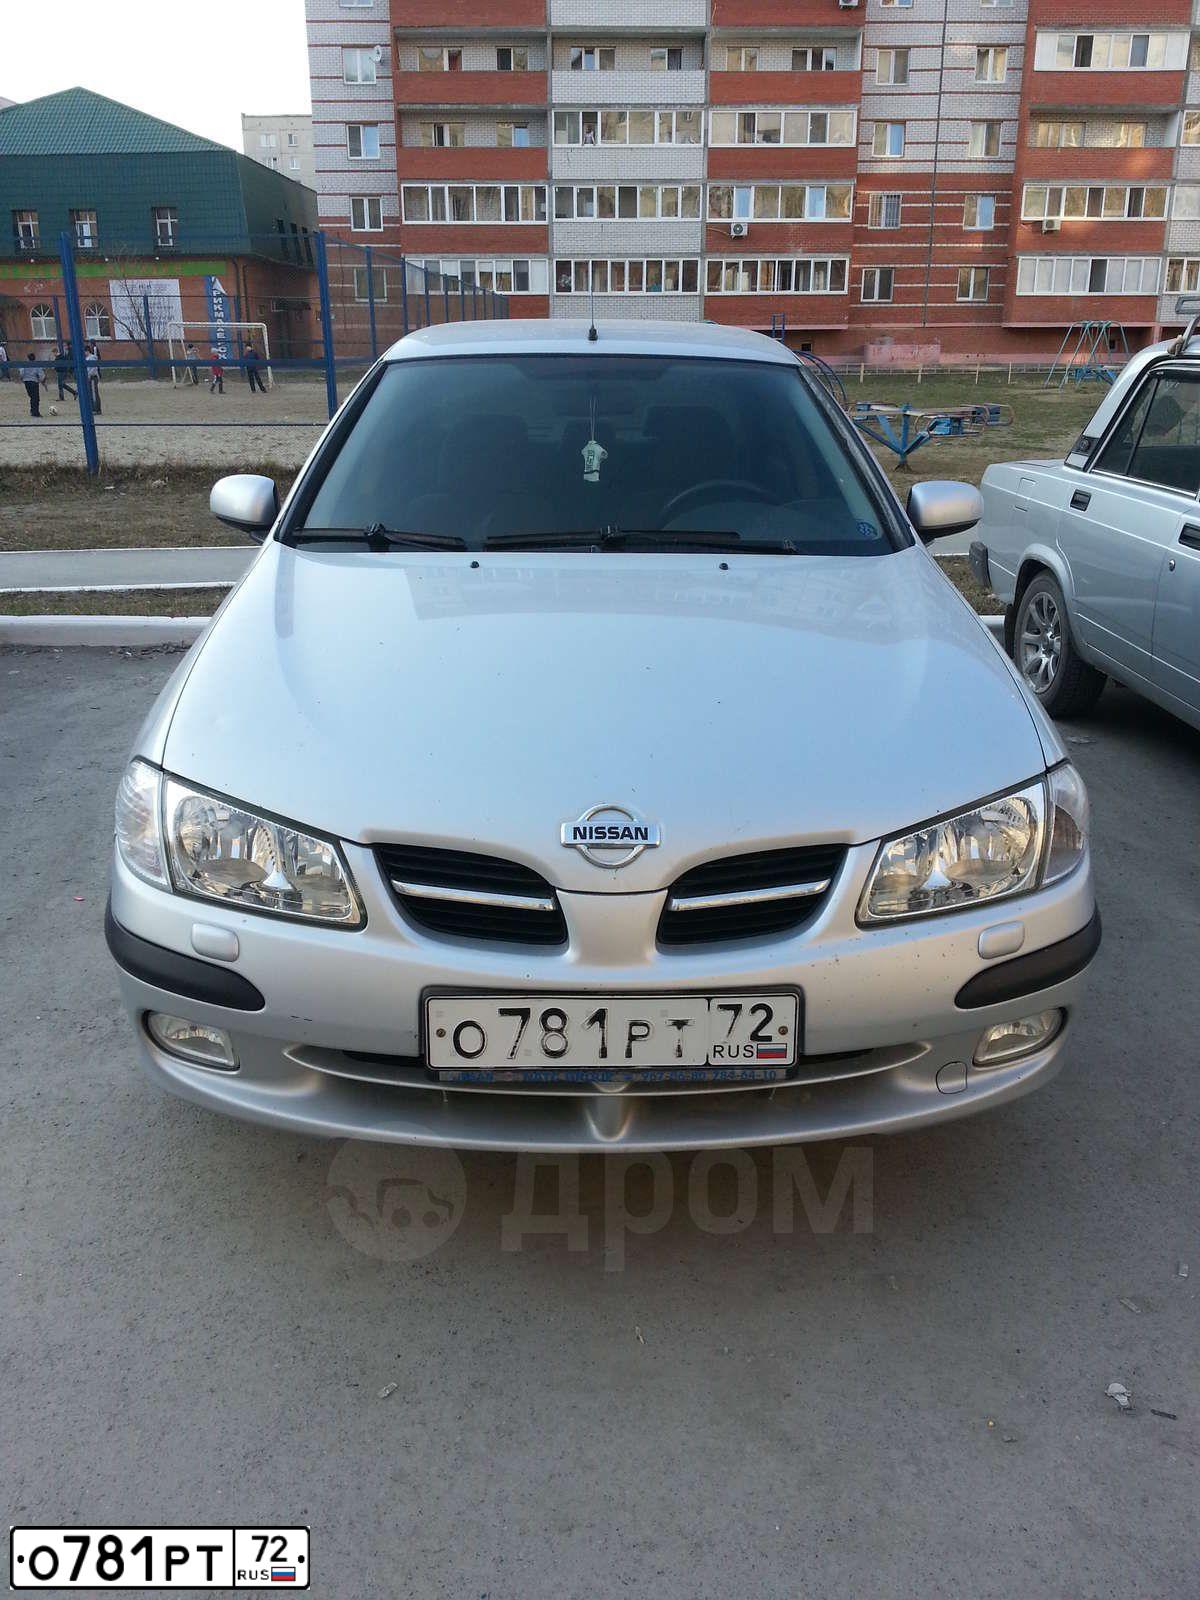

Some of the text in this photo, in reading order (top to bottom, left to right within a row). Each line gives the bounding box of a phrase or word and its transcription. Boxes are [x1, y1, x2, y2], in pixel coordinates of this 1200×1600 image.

[573, 826, 649, 840] NISSAN
[717, 1003, 773, 1042] 72
[713, 1044, 754, 1058] RUS
